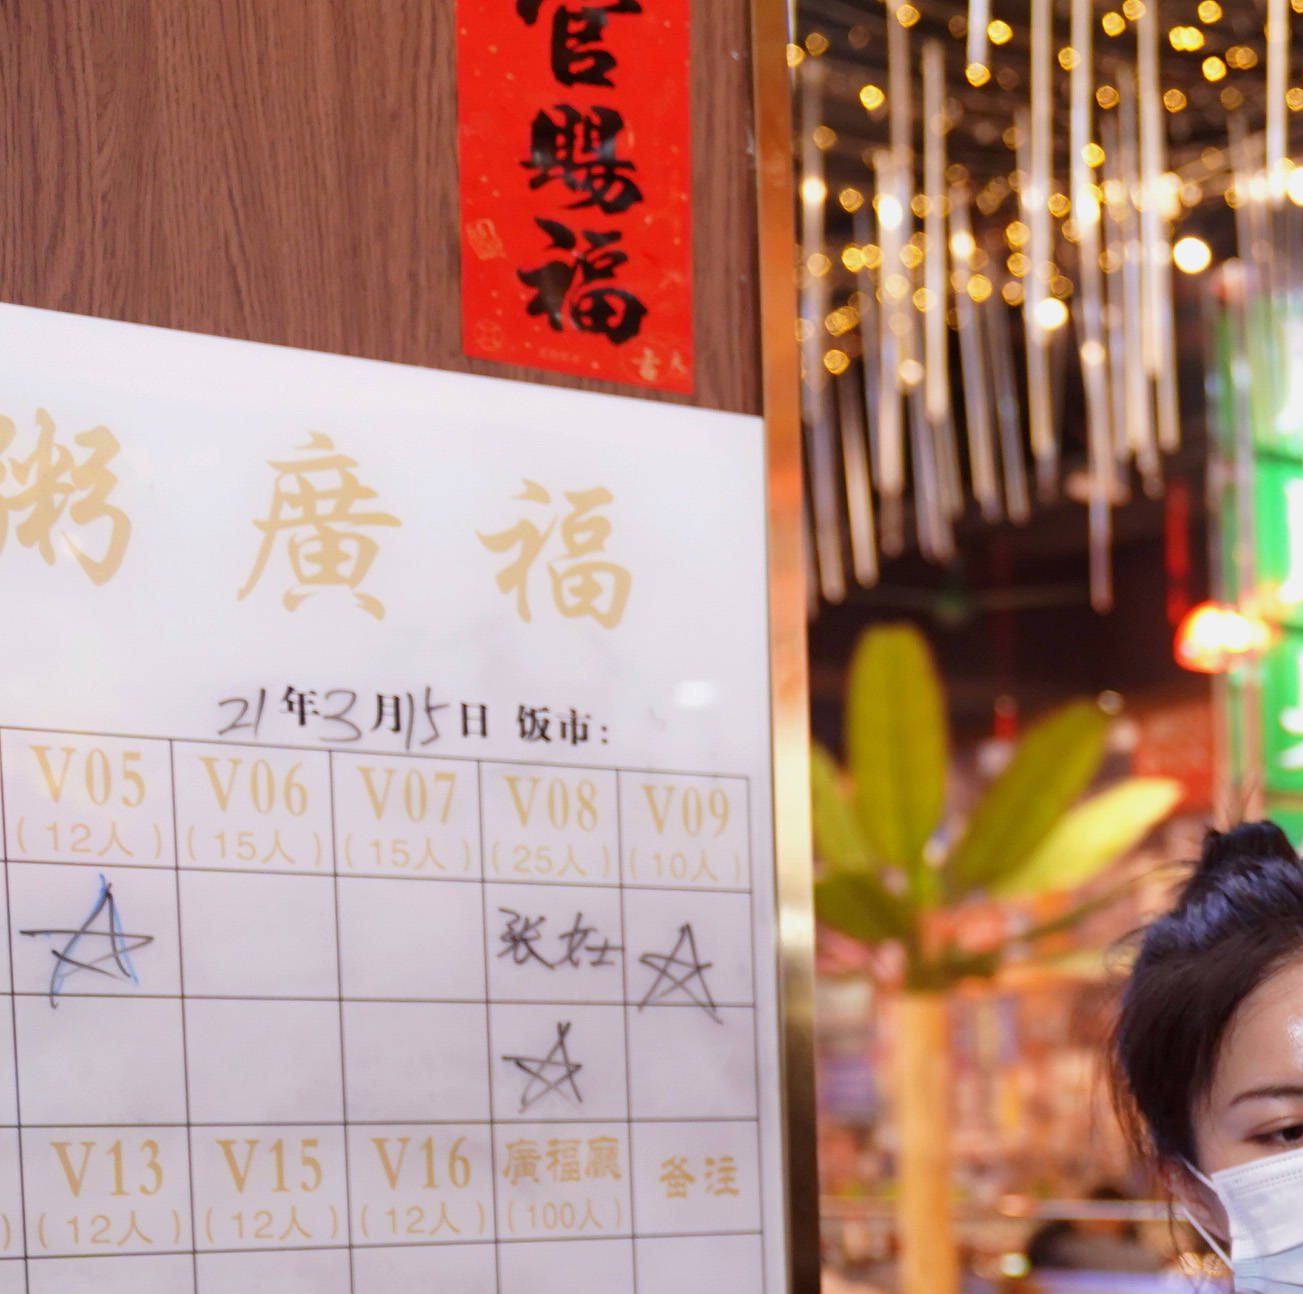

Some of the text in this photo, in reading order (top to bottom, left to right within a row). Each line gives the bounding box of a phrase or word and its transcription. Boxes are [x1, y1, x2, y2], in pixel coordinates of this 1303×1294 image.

[30, 744, 147, 808] V05
[200, 754, 310, 818] V06
[358, 765, 460, 827] V07
[504, 775, 601, 834] V08
[642, 783, 732, 839] V09
[50, 1139, 167, 1198] V13
[216, 1137, 325, 1194] V15
[371, 1136, 473, 1191] V16
[659, 1155, 741, 1199] 备注
